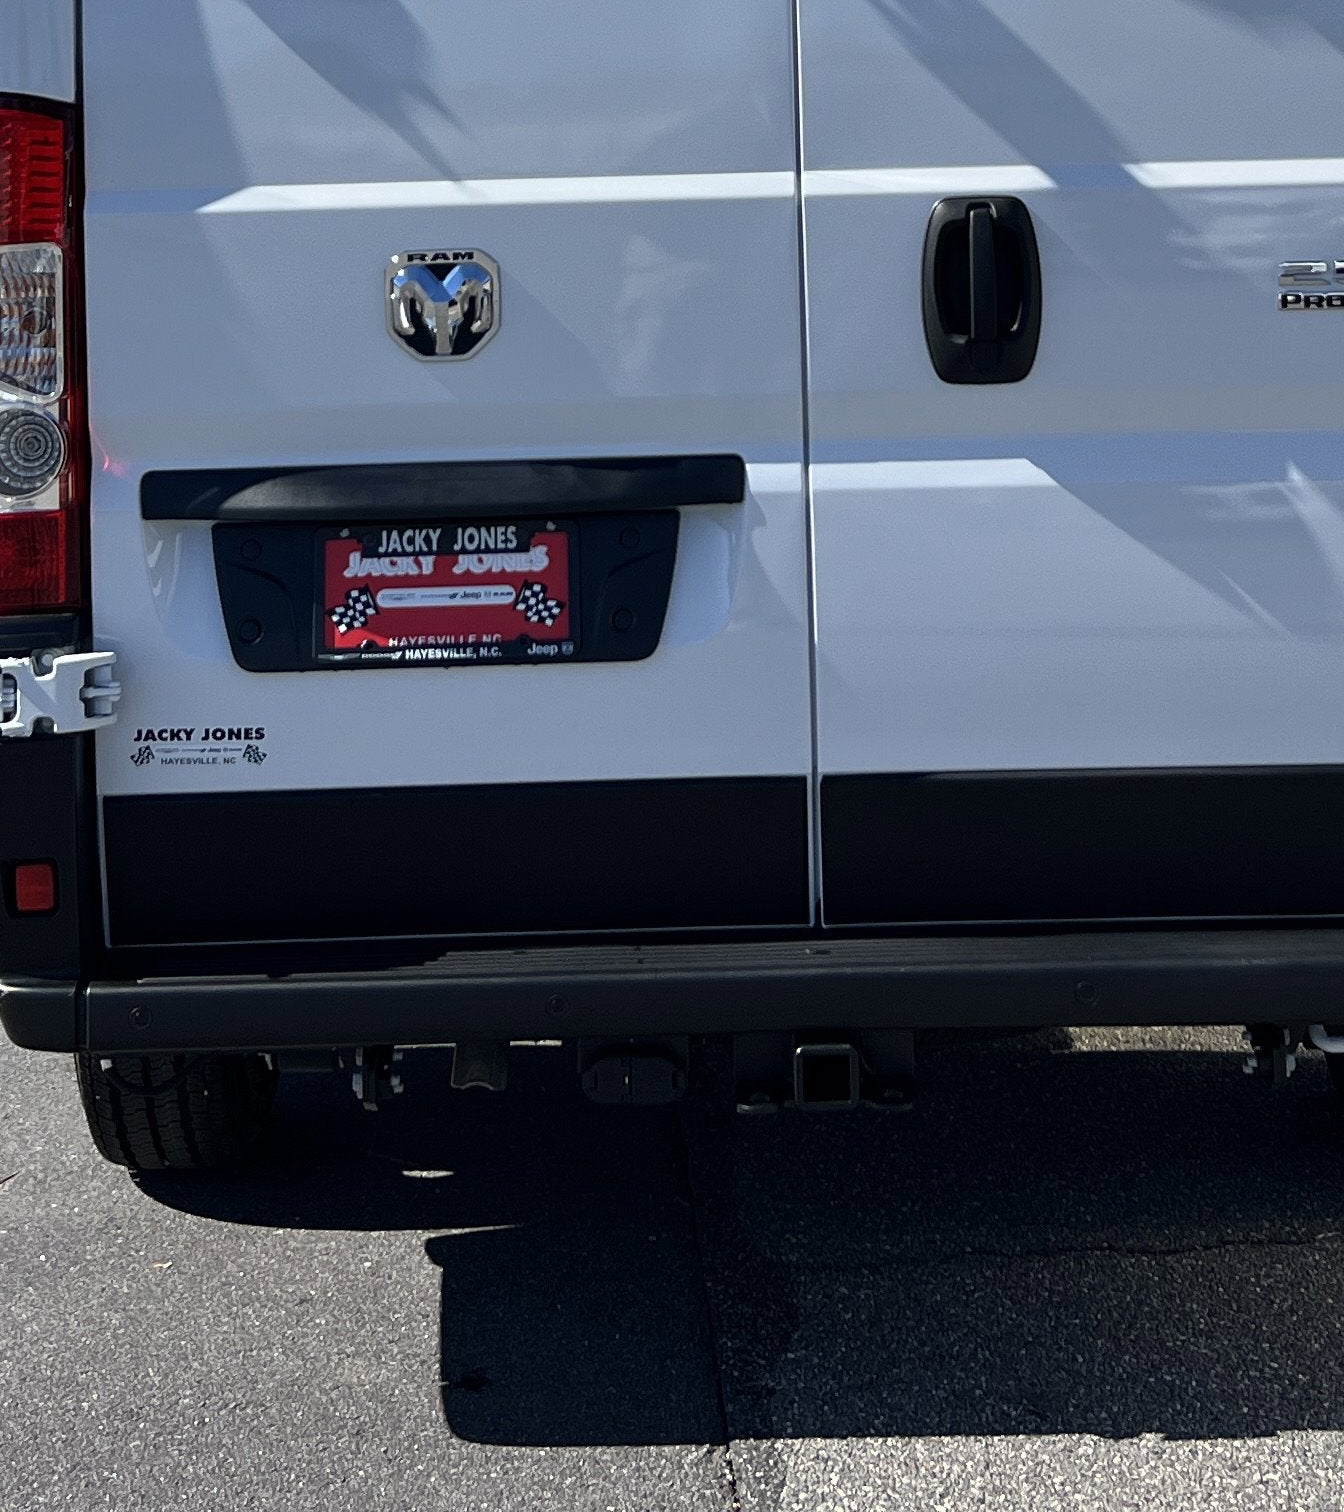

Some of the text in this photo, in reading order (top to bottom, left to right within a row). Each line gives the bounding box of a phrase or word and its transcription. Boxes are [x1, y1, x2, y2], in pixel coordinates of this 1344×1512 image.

[407, 252, 474, 262] RAM
[378, 526, 518, 553] JACKY JONES
[343, 545, 550, 577] JACKY JONES
[405, 647, 477, 659] HAYESVILLE,
[527, 643, 558, 656] Jeep
[134, 727, 265, 742] JACKY JONES
